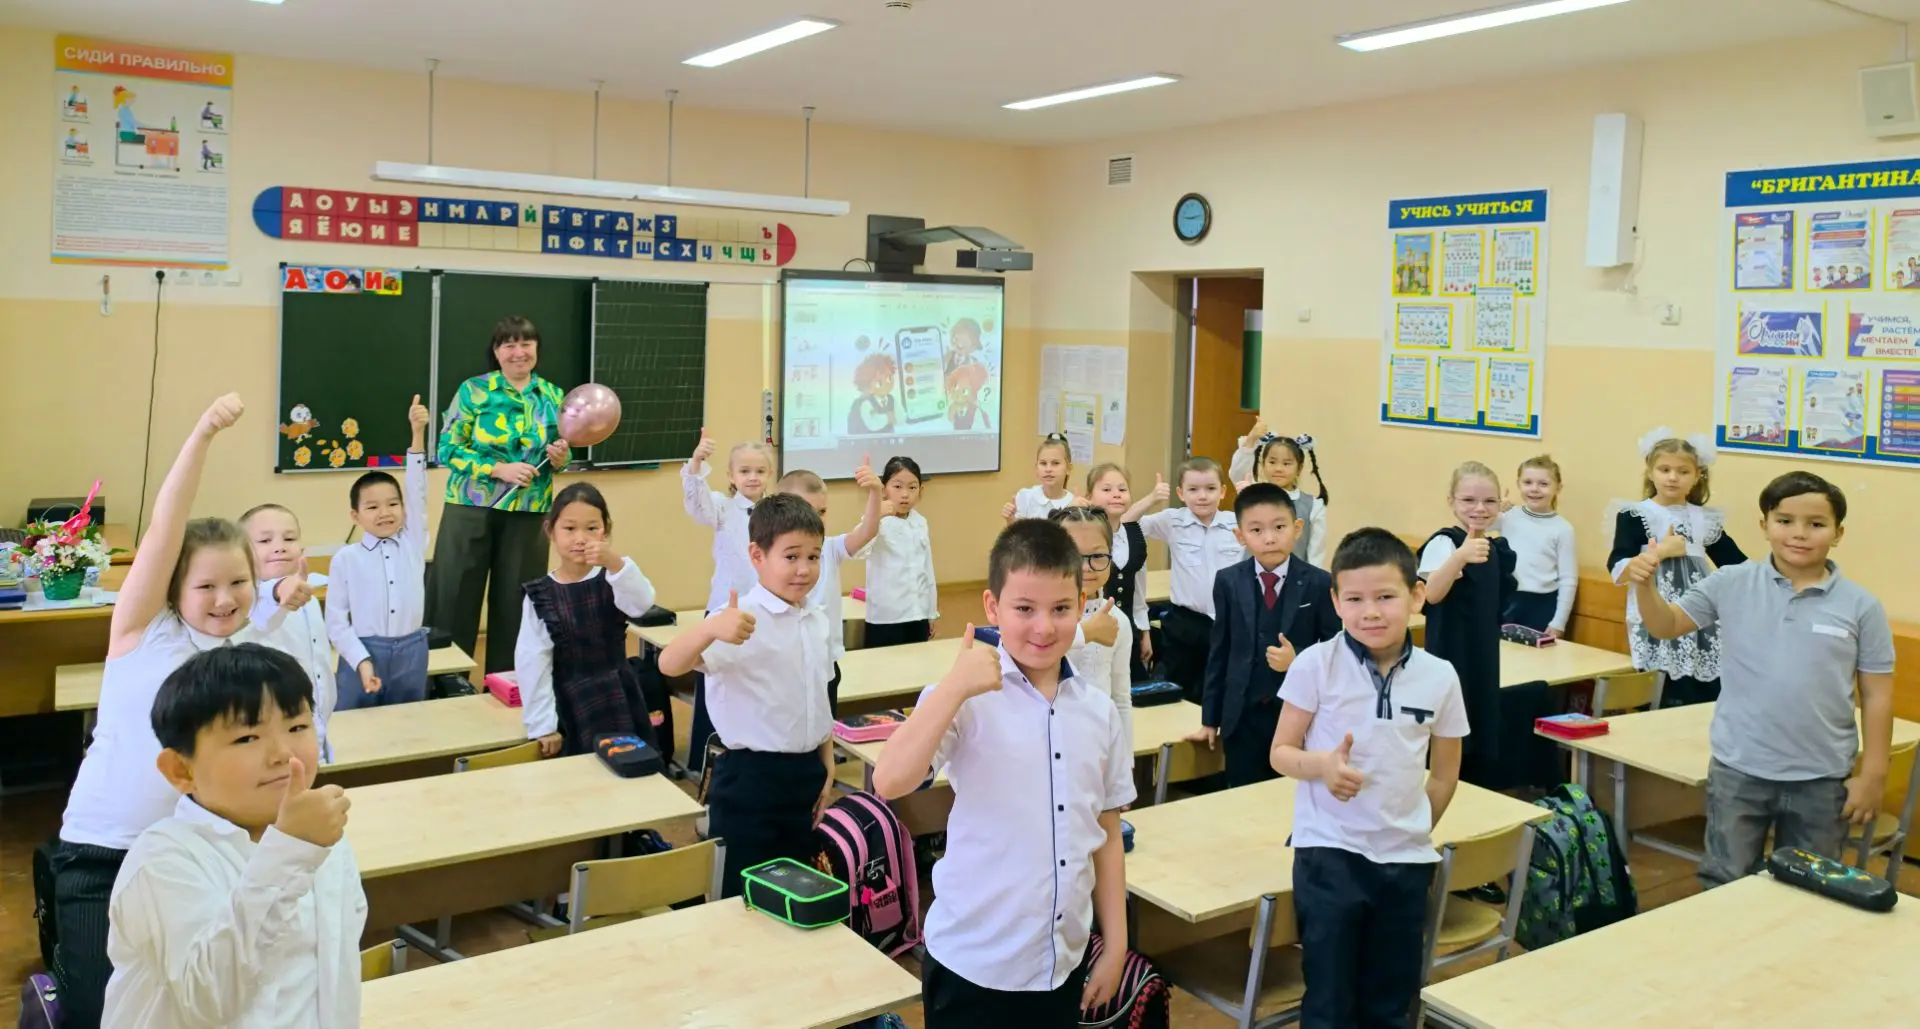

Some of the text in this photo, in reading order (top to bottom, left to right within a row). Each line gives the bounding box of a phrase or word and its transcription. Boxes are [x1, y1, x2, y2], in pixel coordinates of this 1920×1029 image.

[63, 46, 226, 76] СИДИ ПРАВИЛЬНО
[1400, 199, 1535, 220] УЧИСЬ УЧИТЬСЯ
[285, 267, 383, 290] А О И
[1867, 315, 1912, 324] УЧИМСЯ,
[1861, 336, 1908, 344] МЕЧТАЕМ
